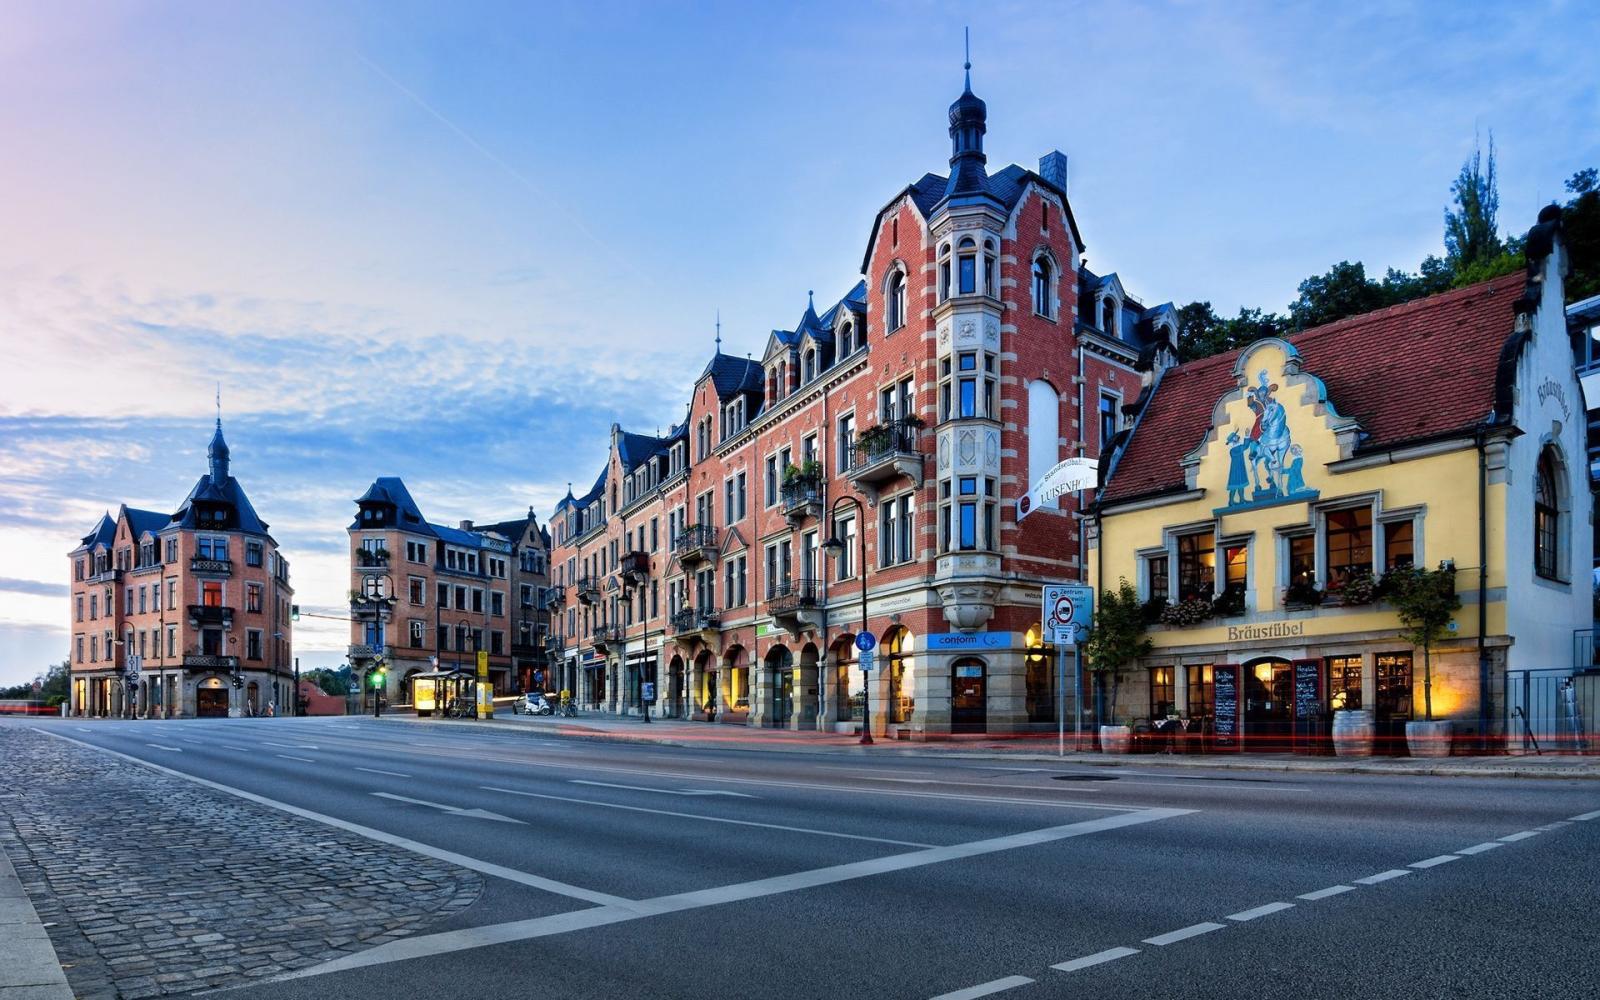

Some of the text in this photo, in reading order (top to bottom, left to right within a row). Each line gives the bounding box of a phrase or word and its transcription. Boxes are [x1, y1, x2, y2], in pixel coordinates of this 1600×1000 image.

[1041, 477, 1088, 504] LUISENHOF
[1228, 622, 1303, 640] Bräustübel
[939, 636, 976, 645] conform
